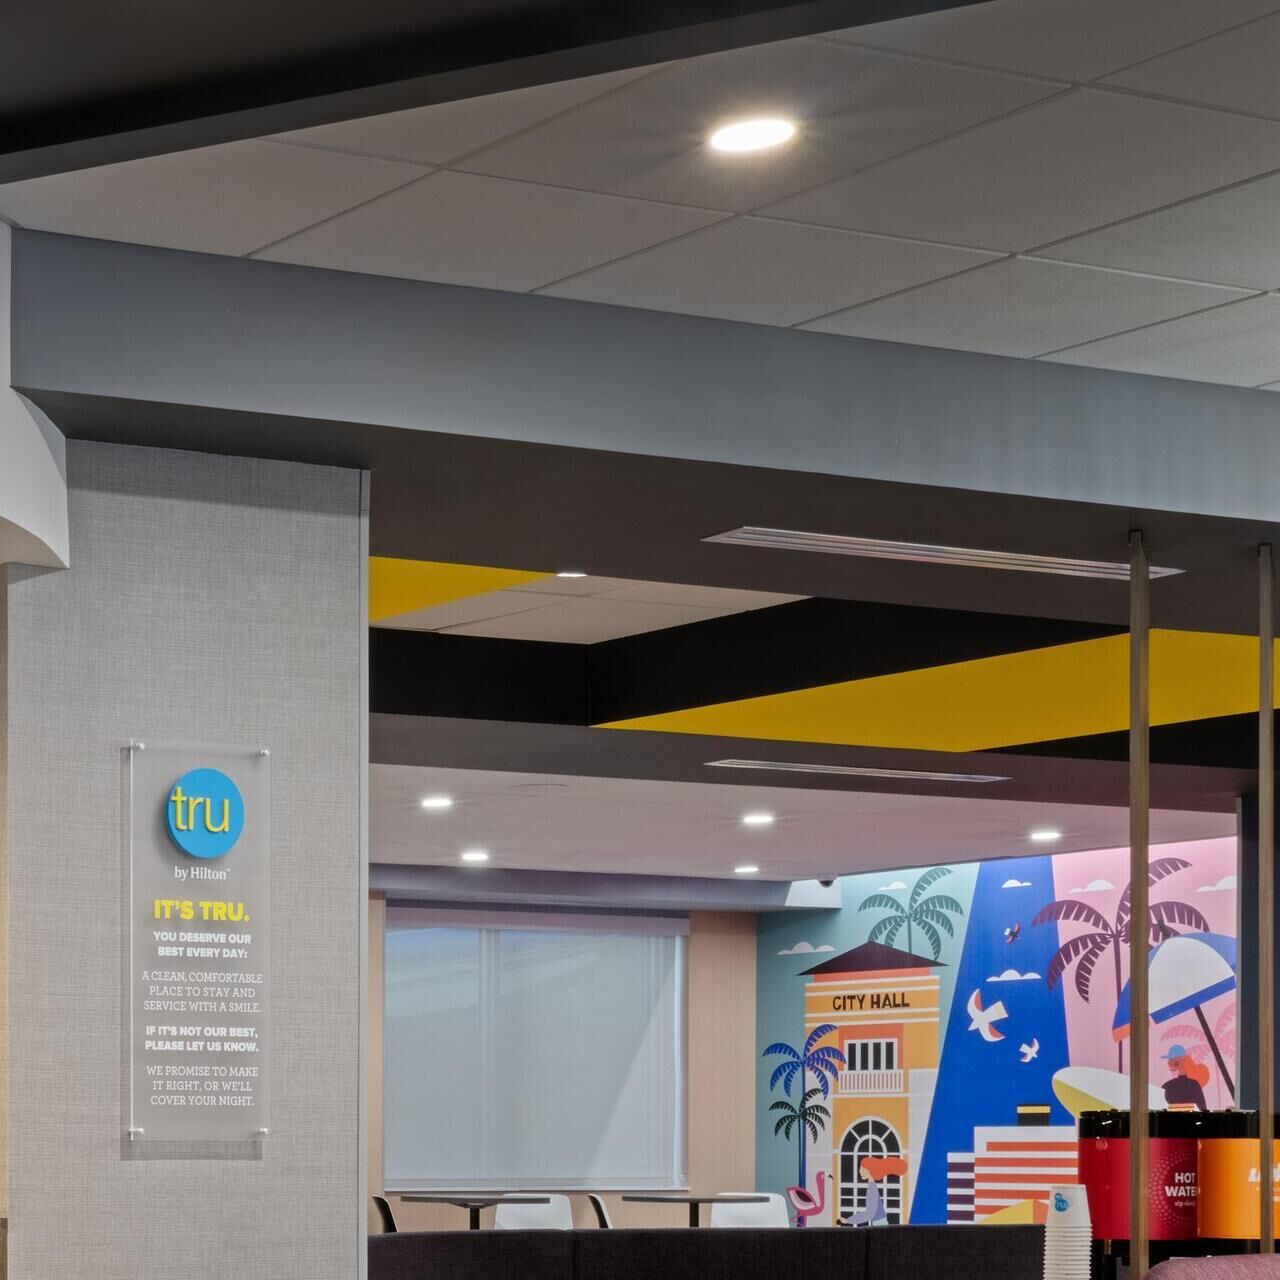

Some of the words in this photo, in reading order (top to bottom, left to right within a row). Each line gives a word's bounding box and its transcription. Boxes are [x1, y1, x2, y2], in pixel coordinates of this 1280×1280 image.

[171, 786, 230, 833] tru
[174, 866, 188, 881] by
[154, 899, 195, 920] IT'S
[199, 901, 250, 922] TRU.
[153, 931, 177, 941] YOU
[179, 932, 226, 943] DESERVE
[228, 934, 252, 944] OUR
[158, 946, 184, 956] BEST
[186, 947, 220, 958] EVERY
[222, 948, 248, 959] DAY:
[142, 971, 149, 981] A
[151, 971, 187, 983] CLEAN,
[188, 972, 263, 984] COMFORTABLE
[149, 985, 183, 996] PLACE
[185, 986, 201, 997] TO
[203, 987, 230, 997] STAY
[232, 987, 256, 998] AND
[143, 1000, 187, 1011] SERVICE
[188, 1001, 217, 1012] WITH
[219, 1002, 228, 1012] A
[832, 994, 866, 1011] CITY
[871, 992, 910, 1009] HALL
[146, 1025, 156, 1035] IF
[158, 1026, 177, 1036] IT'S
[179, 1026, 202, 1036] NOT
[204, 1027, 227, 1037] OUR
[229, 1027, 258, 1039] BEST,
[145, 1040, 184, 1050] PLEASE
[186, 1041, 205, 1051] LET
[207, 1041, 222, 1051] US
[223, 1042, 259, 1052] KNOW.
[146, 1065, 163, 1076] WE
[165, 1066, 211, 1076] PROMISE
[212, 1066, 227, 1076] TO
[229, 1066, 259, 1077] MAKE
[152, 1080, 164, 1091] IT
[166, 1081, 202, 1092] RIGHT,
[204, 1081, 219, 1091] OR
[221, 1081, 252, 1092] WE'LL
[150, 1095, 186, 1105] COVER
[188, 1095, 217, 1106] YOUR
[219, 1096, 255, 1106] NIGHT.
[1174, 1172, 1196, 1184] HOT
[1164, 1185, 1198, 1197] WATE
